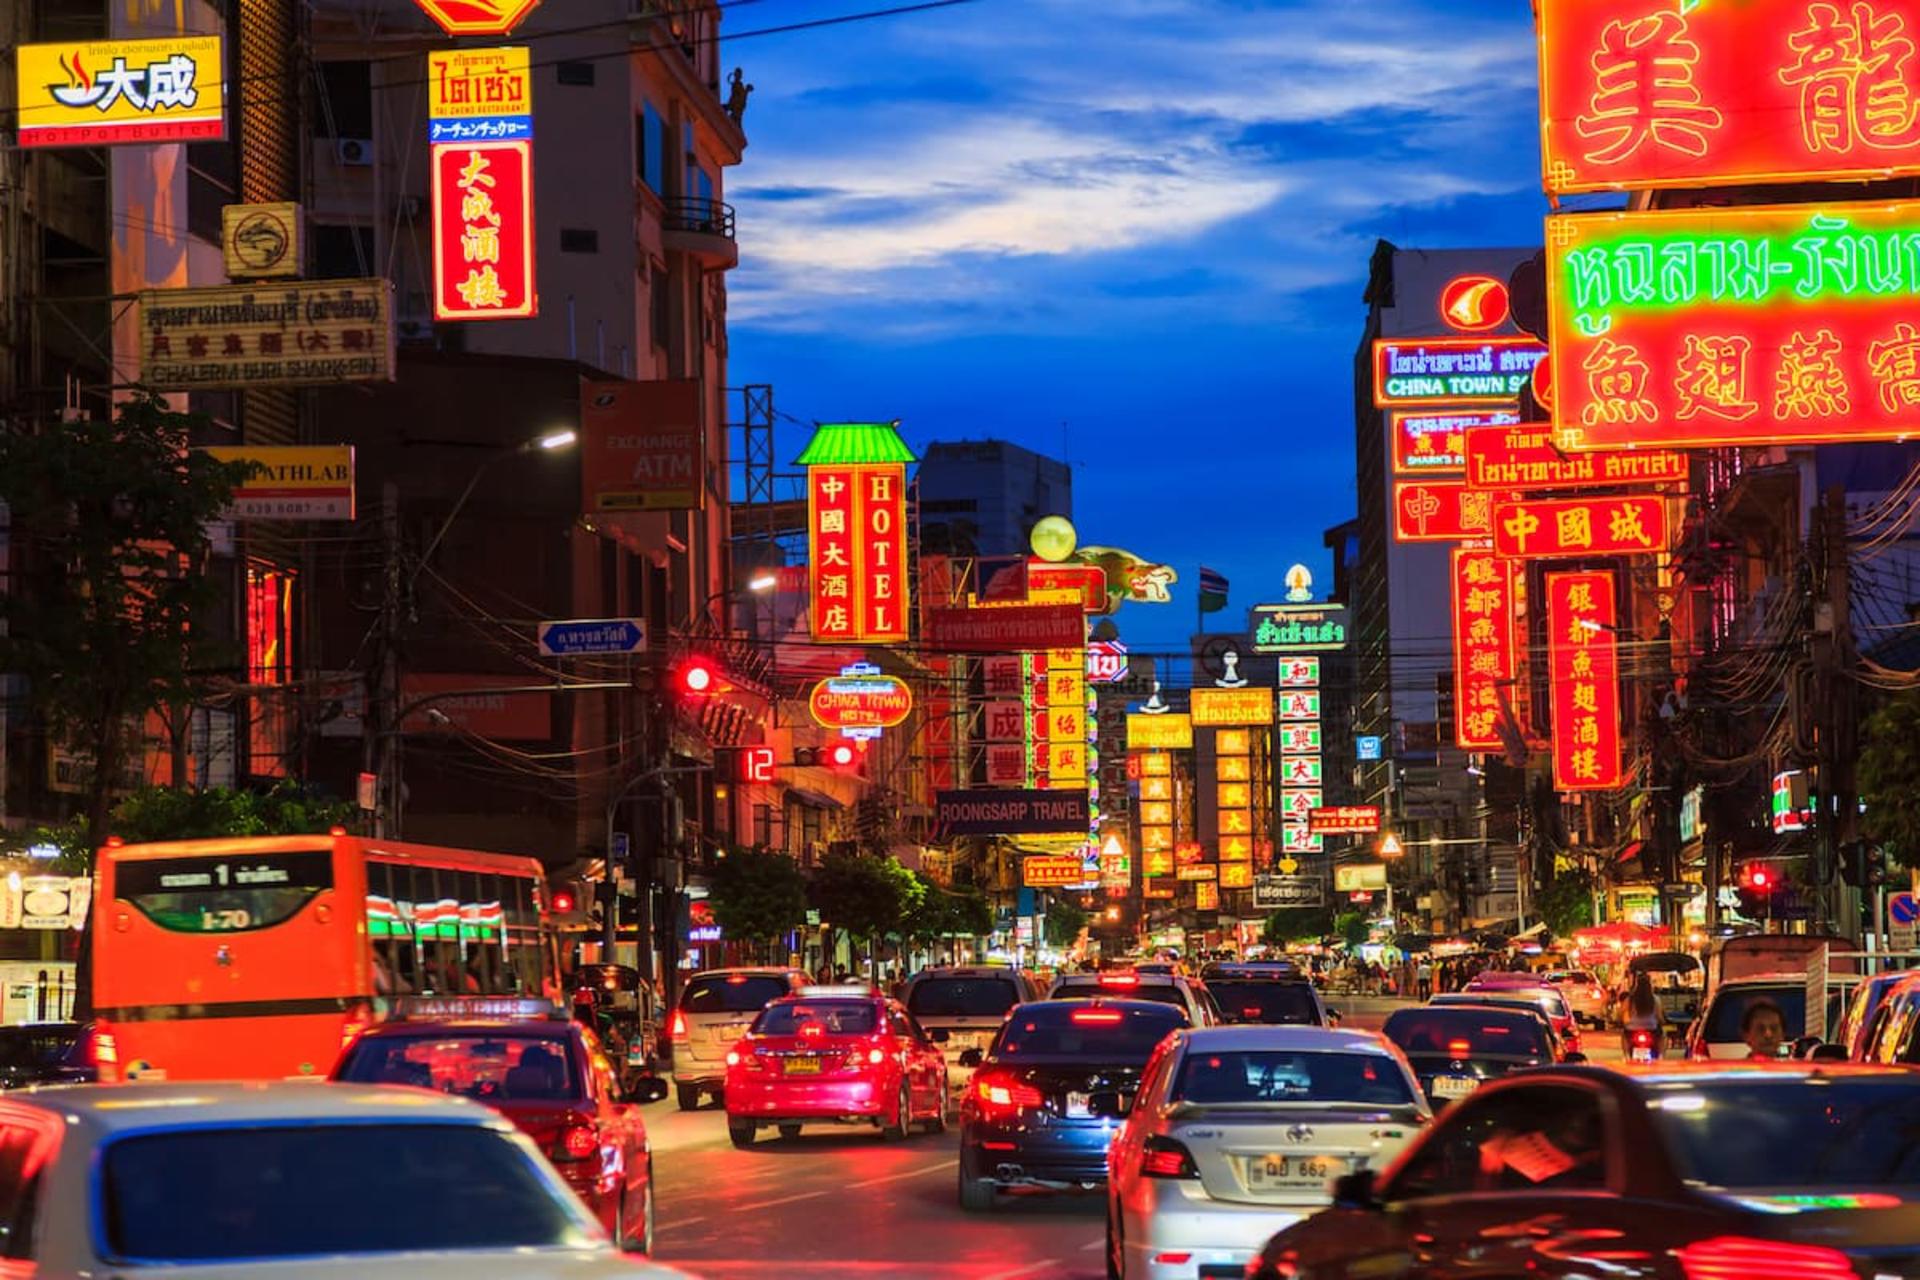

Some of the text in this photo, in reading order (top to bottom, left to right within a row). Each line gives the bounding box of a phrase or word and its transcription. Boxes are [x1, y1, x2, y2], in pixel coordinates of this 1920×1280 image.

[96, 54, 198, 113] 大成
[28, 125, 215, 144] Hot Pot Buffet
[456, 151, 508, 309] 大成酒樓
[1386, 346, 1548, 374] ไชน่าทาวน์ สกา
[1386, 377, 1445, 396] CHINA
[1448, 375, 1505, 394] TOWN
[606, 435, 693, 449] EXCHANGE
[634, 454, 692, 479] ATM
[1474, 451, 1681, 484] ไชน่าทาวน์ สกาล่า
[1504, 503, 1652, 554] 中國城
[820, 475, 849, 632] 中國大酒店
[870, 476, 892, 631] HOTEL
[1567, 583, 1603, 781] 銀都魚翅酒樓
[817, 693, 906, 710] CHINA TOWN
[839, 709, 883, 723] HOTEL
[748, 749, 774, 781] 12
[940, 801, 1084, 822] ROONGSARP TRAVEL
[214, 864, 230, 886] 1
[1299, 1161, 1328, 1178] 662
